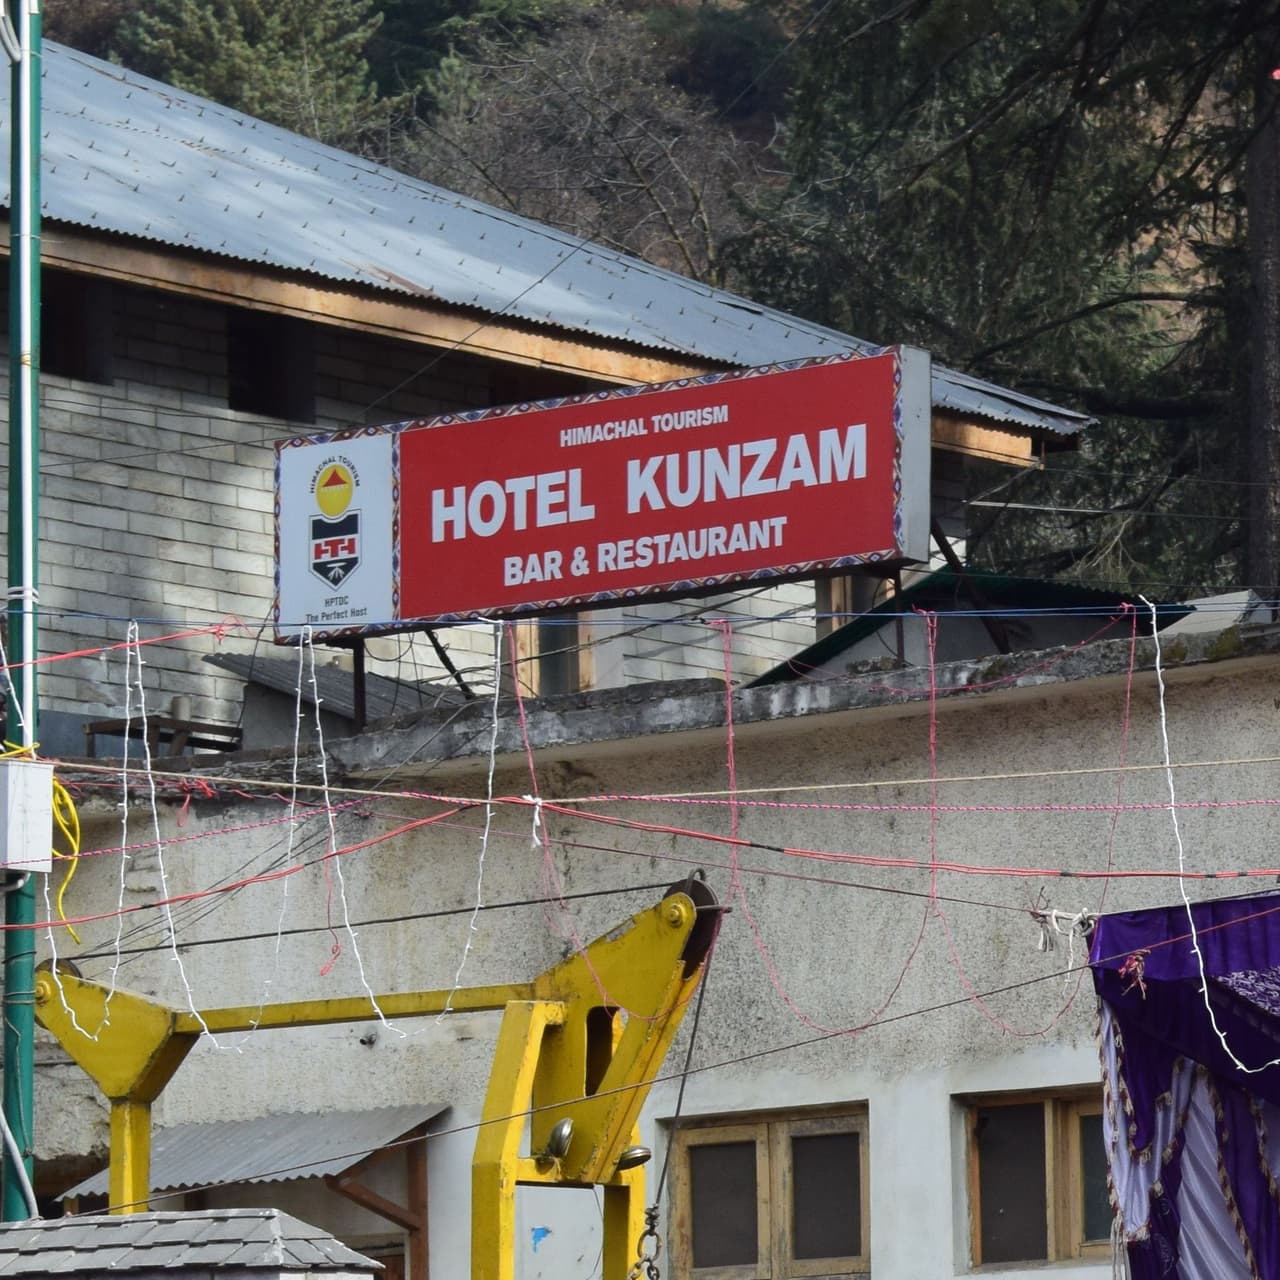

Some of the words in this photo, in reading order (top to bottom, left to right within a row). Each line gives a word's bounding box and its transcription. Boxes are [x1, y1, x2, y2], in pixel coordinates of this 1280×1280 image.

[559, 419, 648, 448] HIMACHAL
[652, 405, 729, 434] TOURISM
[431, 467, 595, 543] HOTEL
[626, 424, 867, 514] KUNZAM
[504, 549, 563, 587] BAR
[570, 547, 590, 576] &
[598, 516, 788, 572] RESTAURANT
[306, 613, 318, 623] The
[321, 609, 348, 621] Perfect
[350, 607, 367, 618] Host
[325, 596, 349, 607] HPTDC
